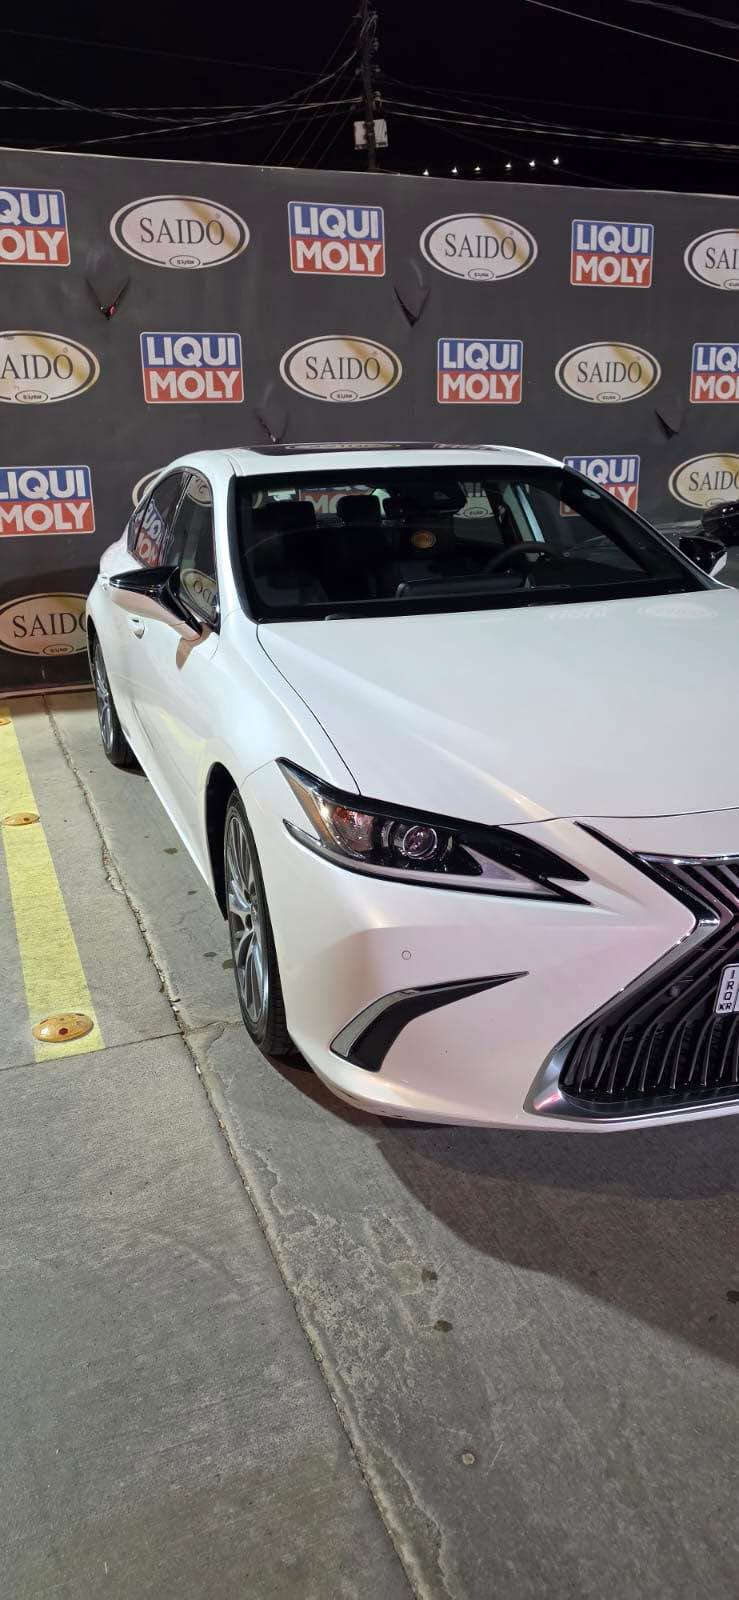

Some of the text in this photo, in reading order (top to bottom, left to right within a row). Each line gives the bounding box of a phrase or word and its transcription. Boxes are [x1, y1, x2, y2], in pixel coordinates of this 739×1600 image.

[139, 217, 225, 246] SAIDO
[293, 205, 379, 240] LIQUI
[444, 233, 517, 260] SAIDO
[576, 224, 649, 255] LIQUI
[296, 241, 383, 271] MOLY
[575, 256, 650, 284] MOLY
[147, 336, 237, 367] LIQUI
[443, 342, 518, 372] LIQUI
[697, 347, 739, 372] LIQ
[305, 356, 381, 381] SAIDO
[576, 361, 642, 384] SAIDO
[149, 369, 239, 400] MOLY
[442, 373, 520, 401] MOLY
[0, 502, 90, 532] MOLY
